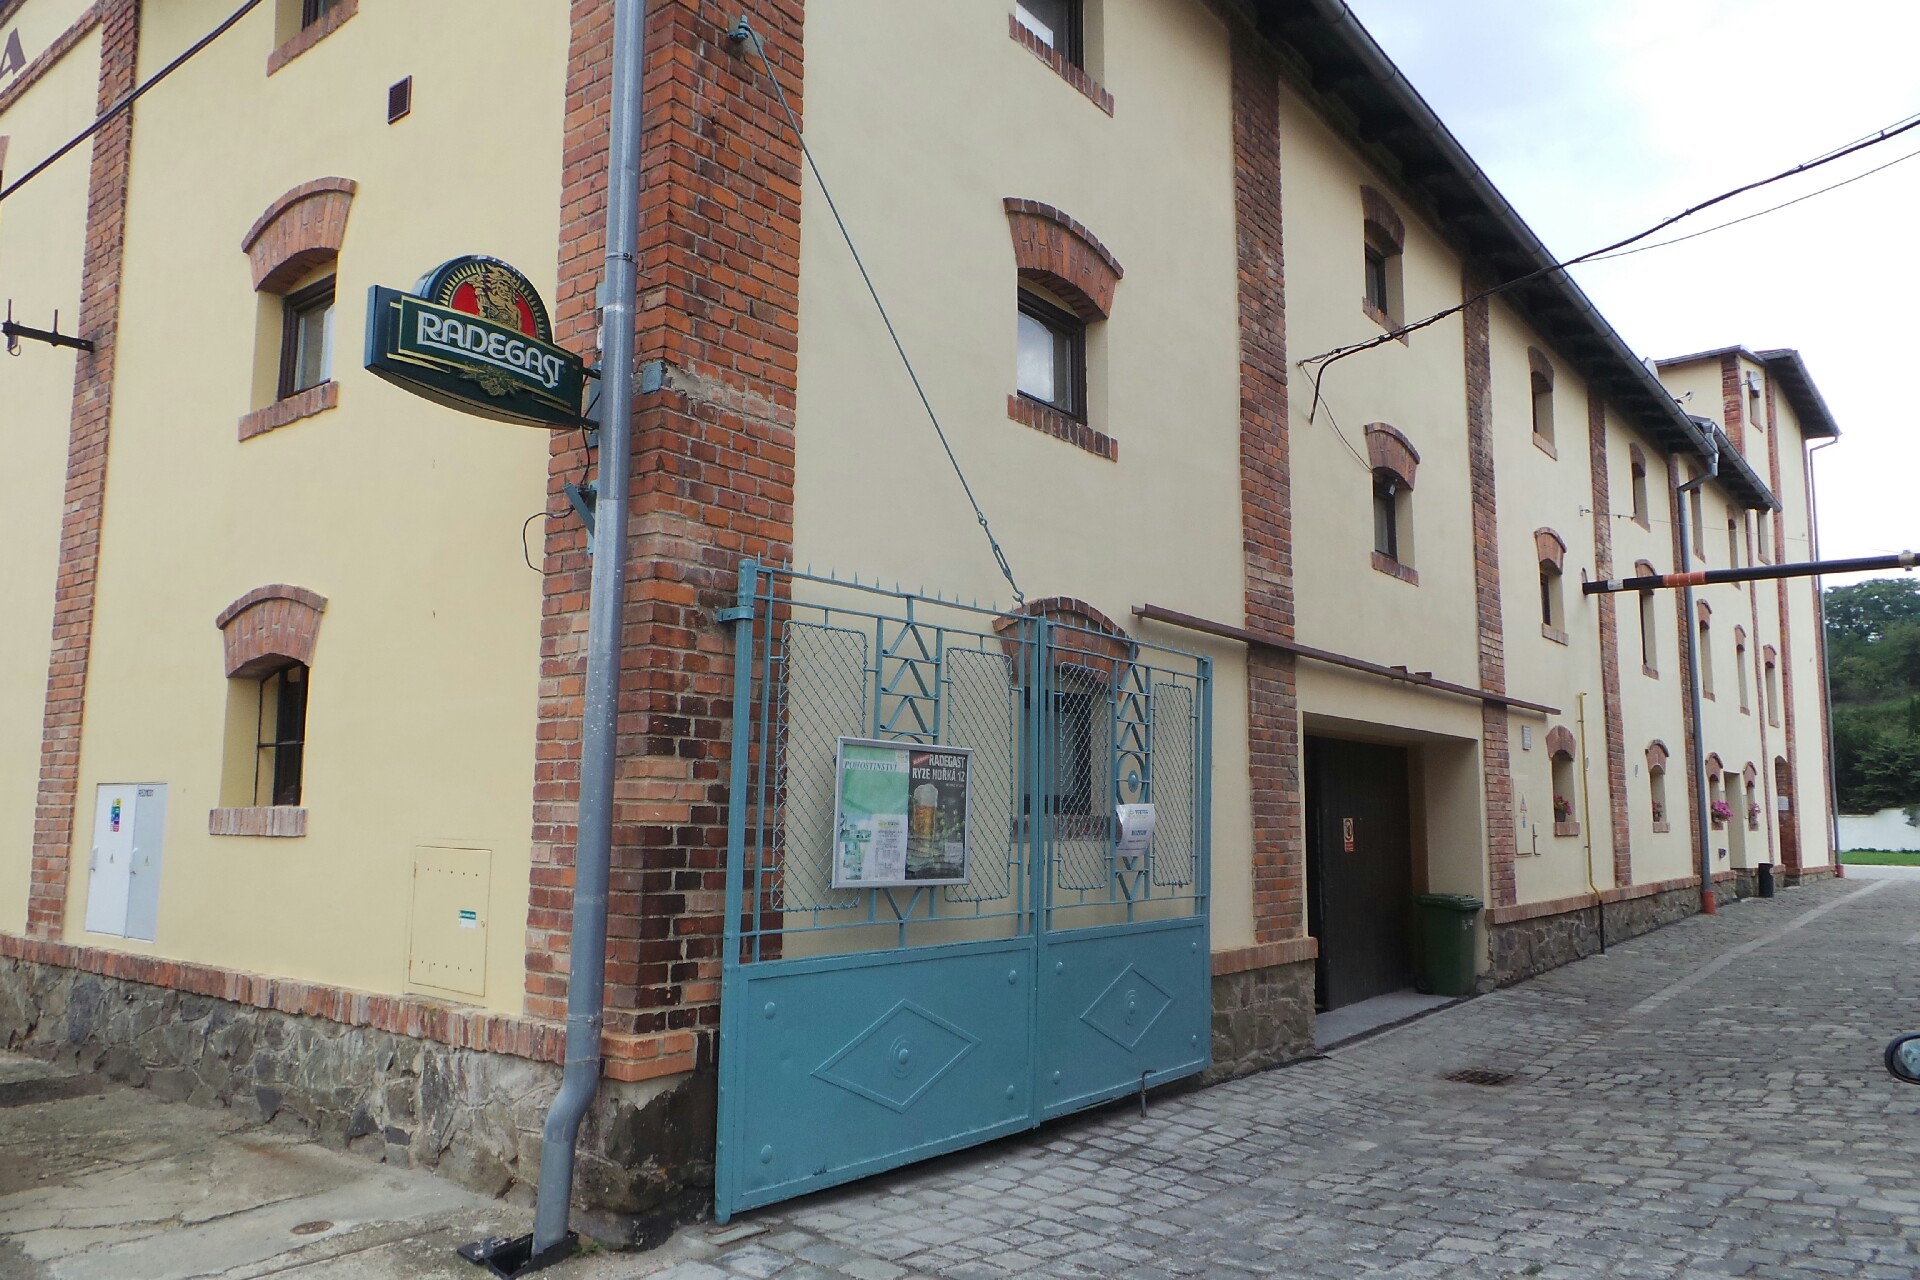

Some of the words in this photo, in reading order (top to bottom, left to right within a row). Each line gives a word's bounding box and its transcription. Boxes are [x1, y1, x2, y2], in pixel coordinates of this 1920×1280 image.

[417, 311, 564, 388] RADEGAST
[929, 754, 966, 768] RADEGAST
[912, 767, 931, 779] RYZE
[957, 770, 966, 782] 12
